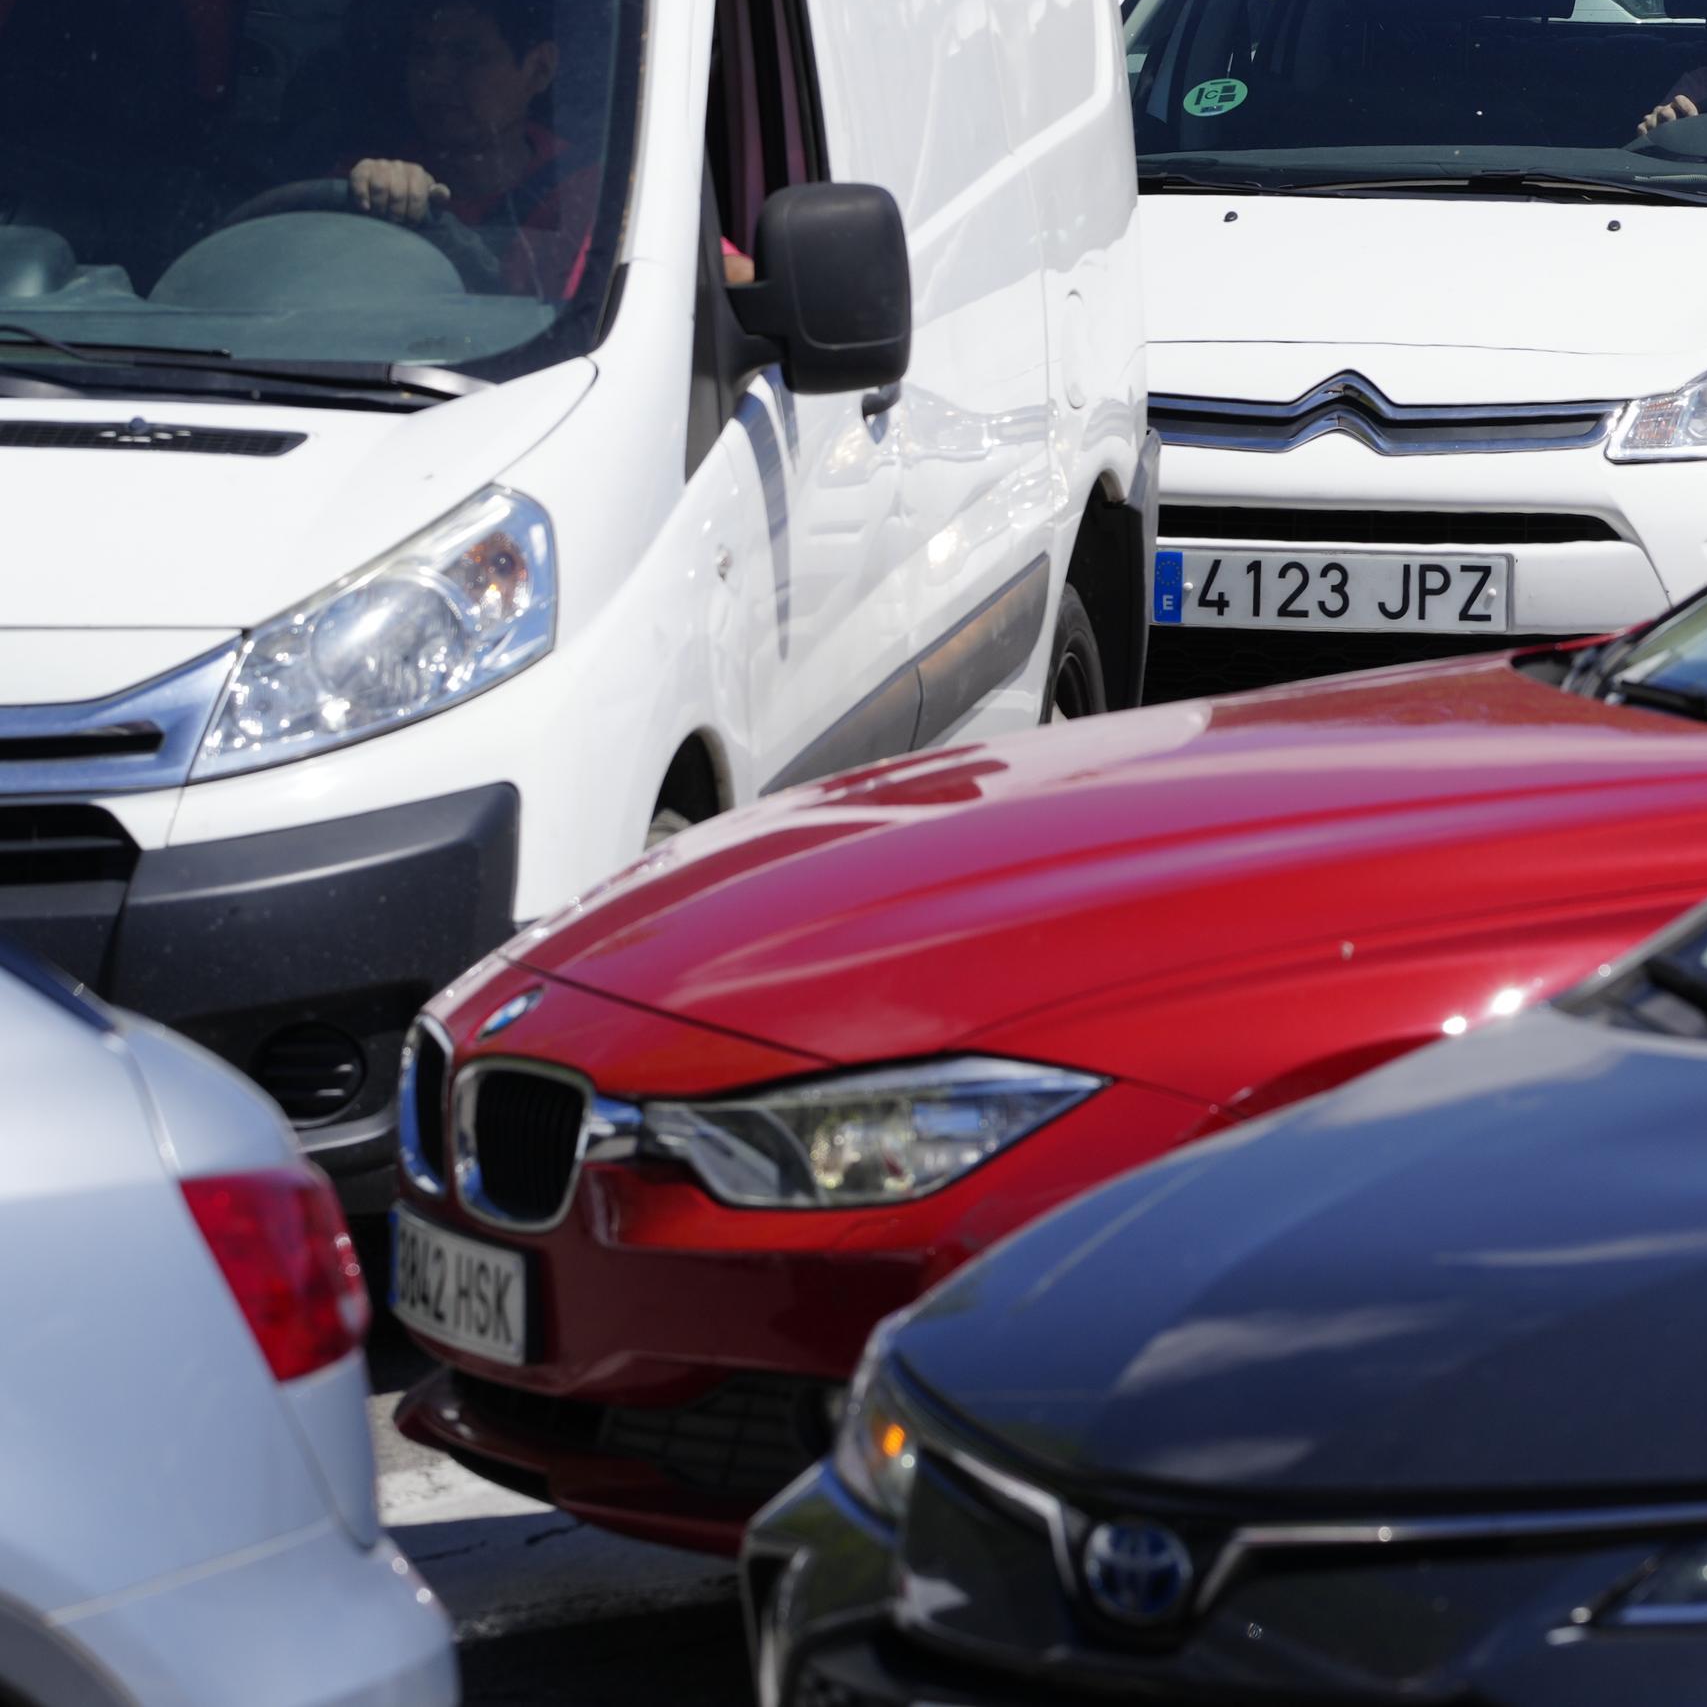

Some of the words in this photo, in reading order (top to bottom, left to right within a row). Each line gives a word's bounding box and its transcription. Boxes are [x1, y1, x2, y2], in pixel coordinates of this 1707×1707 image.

[1162, 595, 1174, 611] E
[1197, 559, 1350, 618] 4123
[1377, 563, 1493, 622] JPZ
[454, 1251, 513, 1343] HSK
